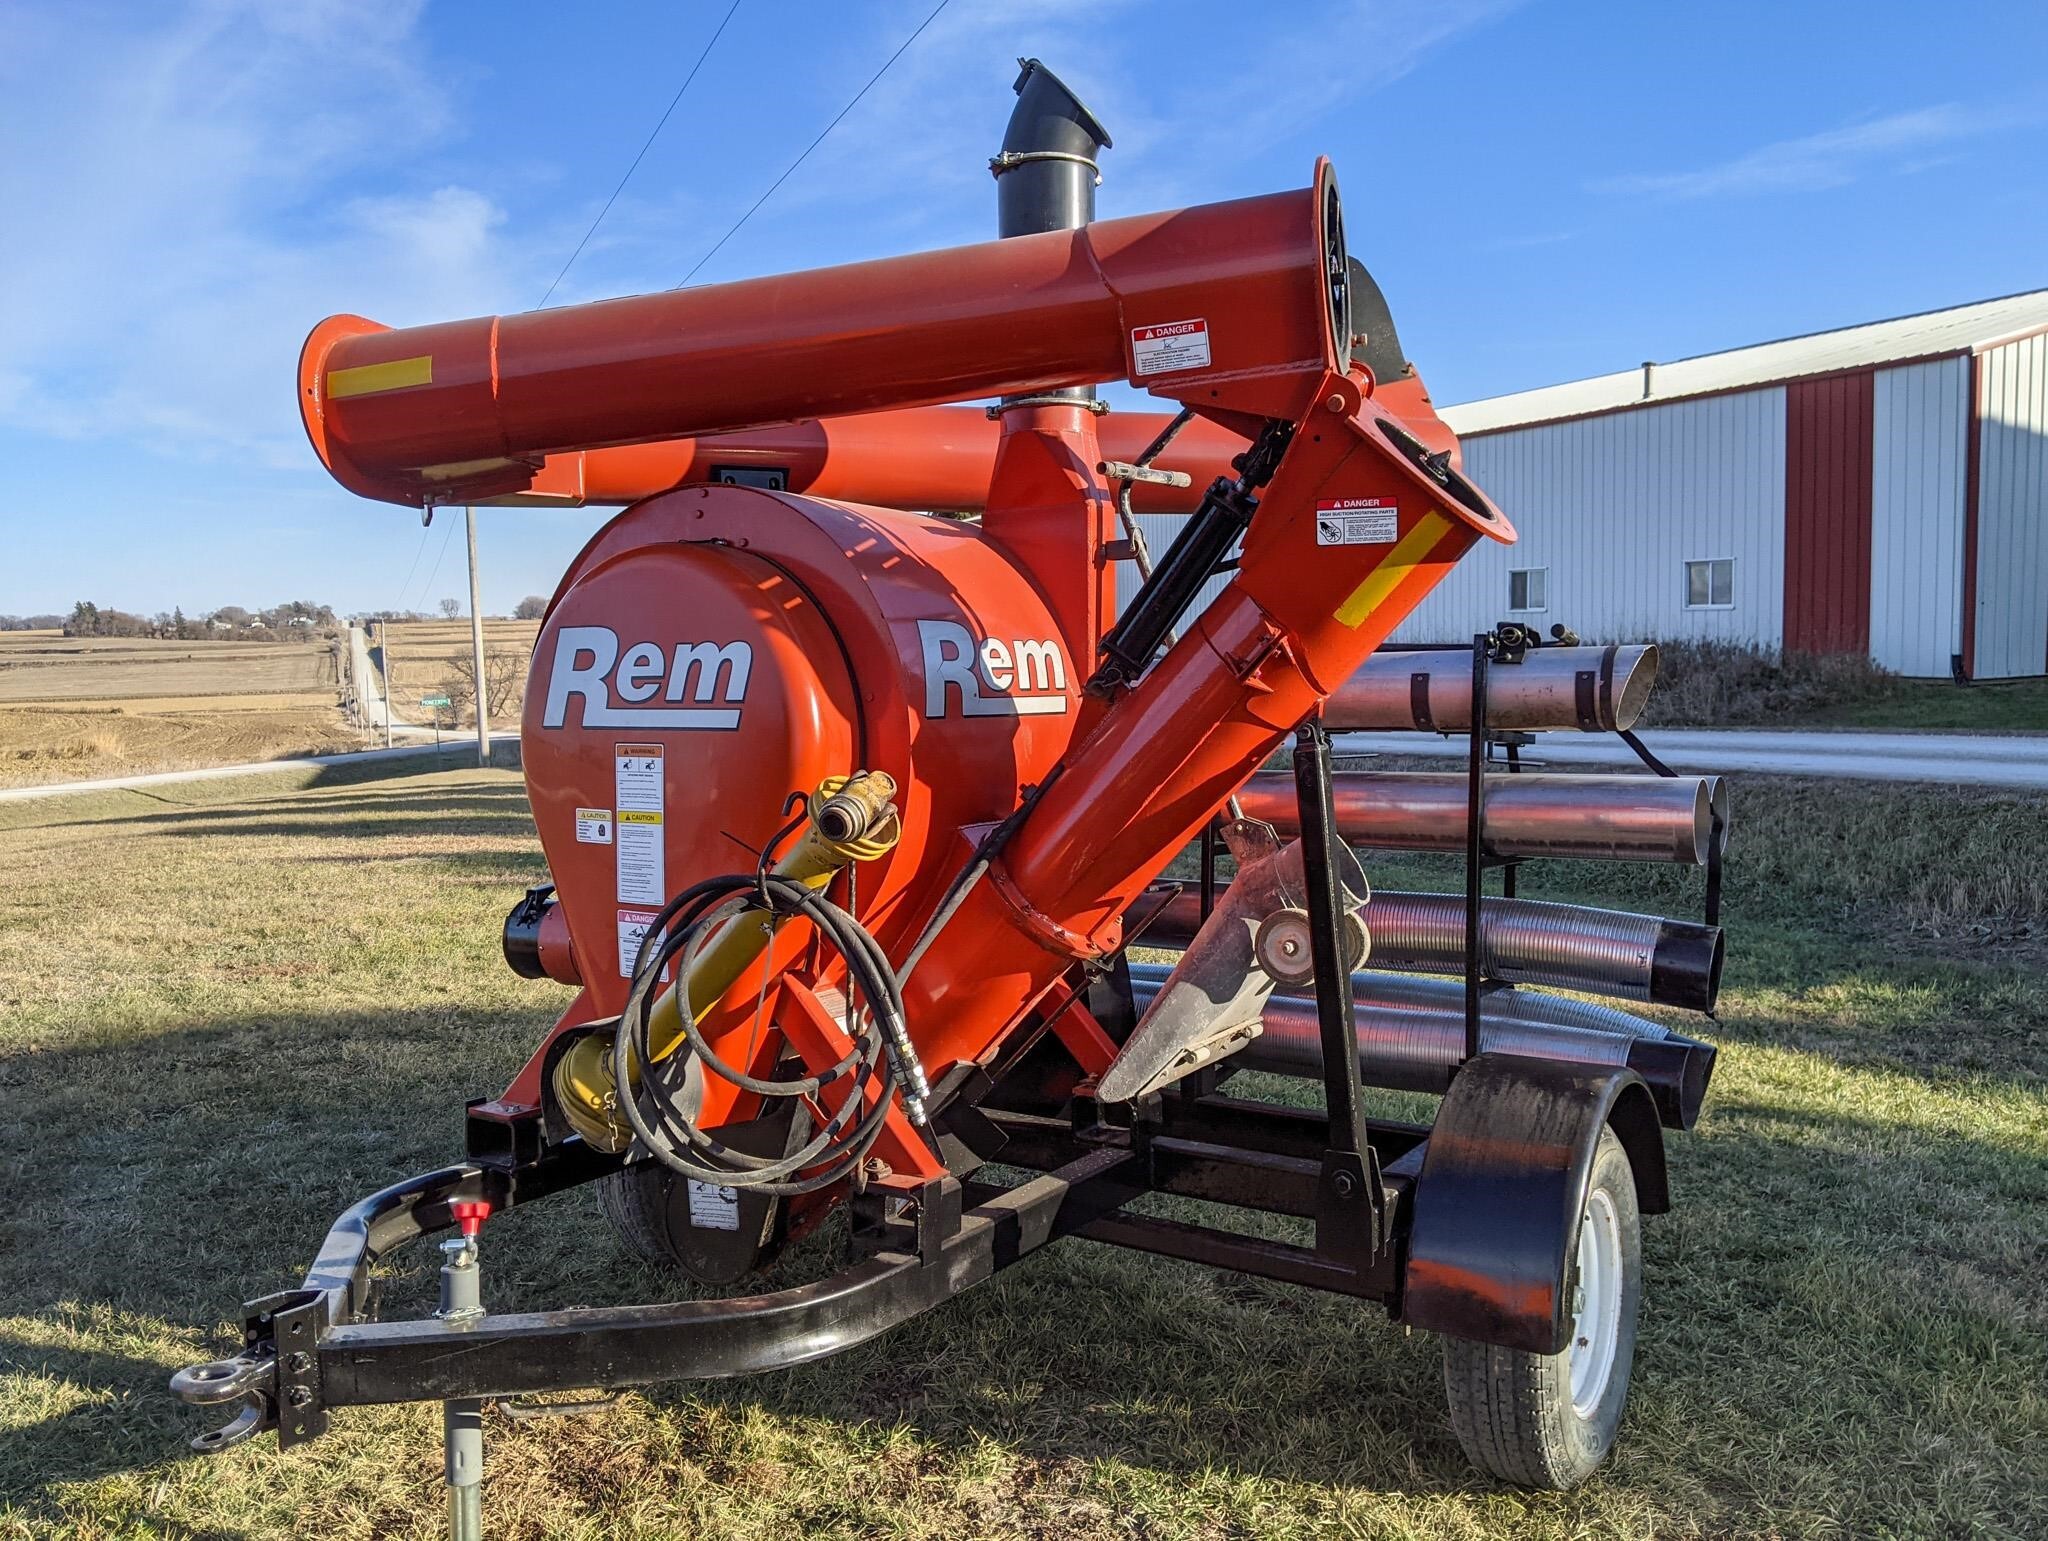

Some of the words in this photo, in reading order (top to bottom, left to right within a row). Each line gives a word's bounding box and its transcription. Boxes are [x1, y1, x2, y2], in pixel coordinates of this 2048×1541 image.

[1156, 324, 1195, 336] DANGER
[1343, 499, 1380, 508] DANGER
[916, 618, 1068, 719] Rem
[542, 625, 753, 730] Rem
[631, 914, 656, 923] DANGE
